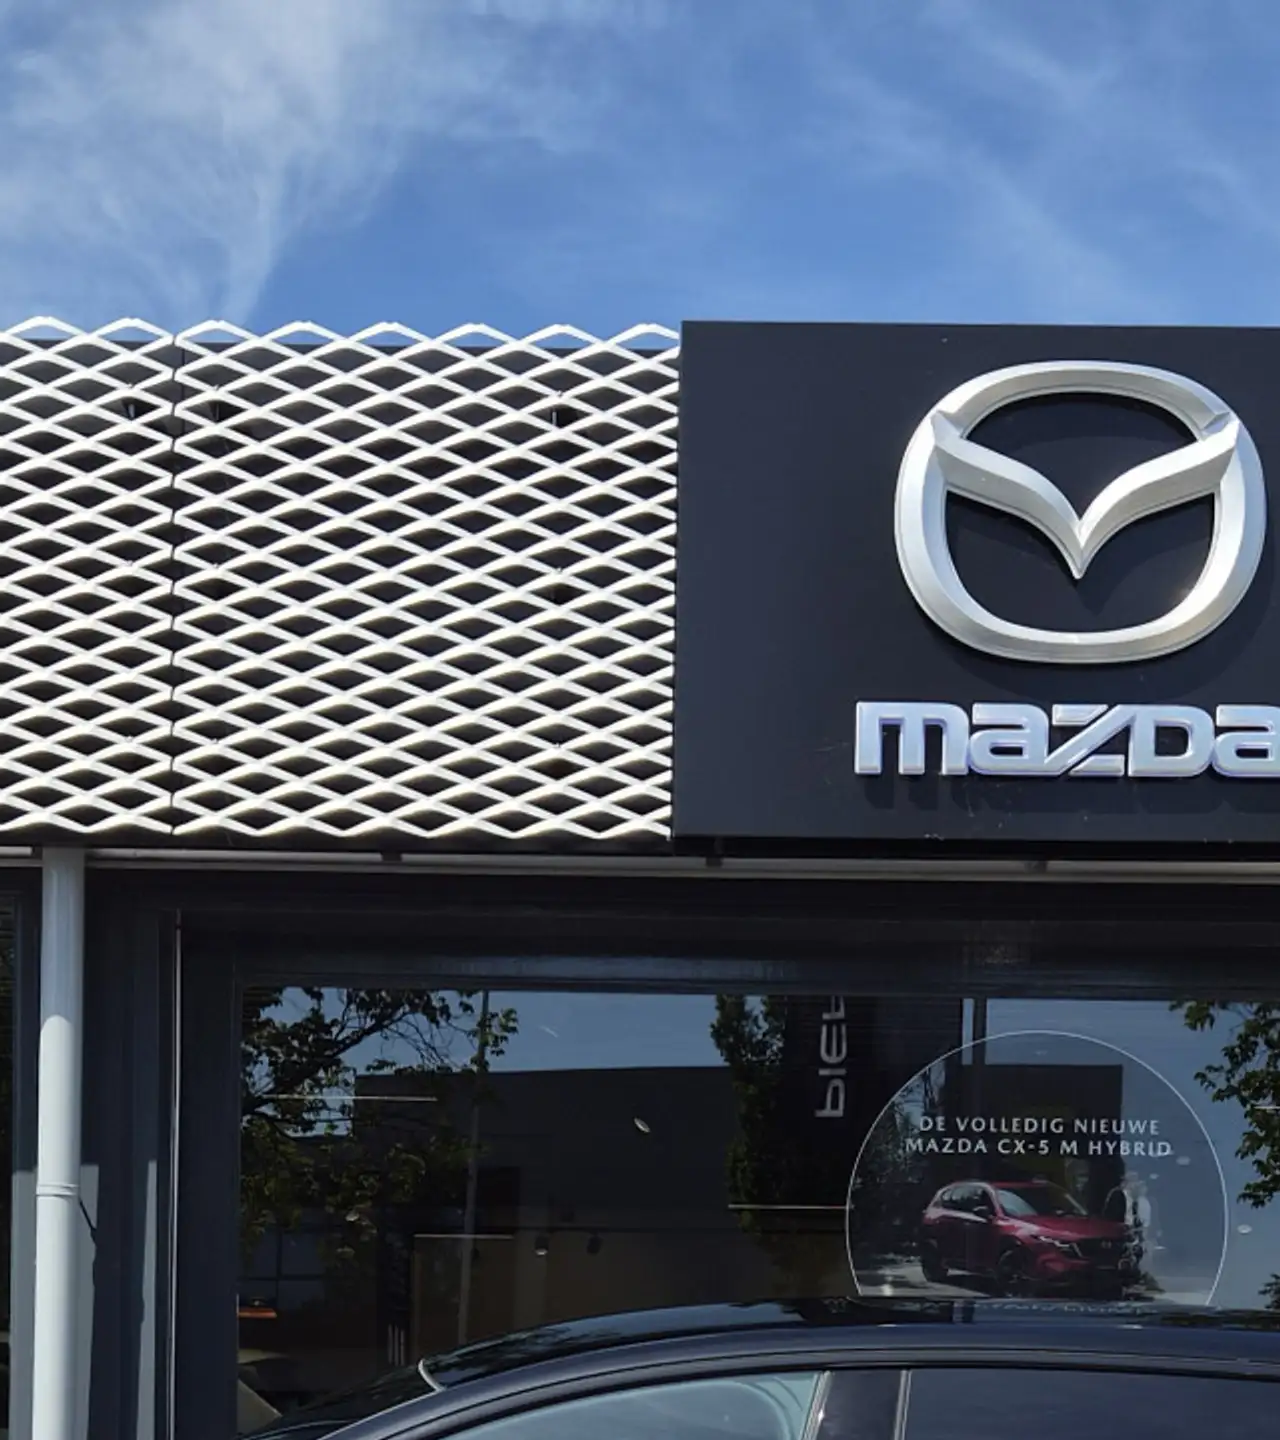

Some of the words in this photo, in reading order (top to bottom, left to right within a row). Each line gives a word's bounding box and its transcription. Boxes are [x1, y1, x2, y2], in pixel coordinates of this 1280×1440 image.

[920, 1116, 946, 1132] DE
[956, 1117, 1064, 1133] VOLLEDIG
[1074, 1118, 1159, 1135] NIEUWE
[905, 1138, 988, 1154] MAZDA
[997, 1138, 1050, 1155] CX-5
[1060, 1140, 1078, 1155] M
[1088, 1140, 1171, 1157] HYBRID
